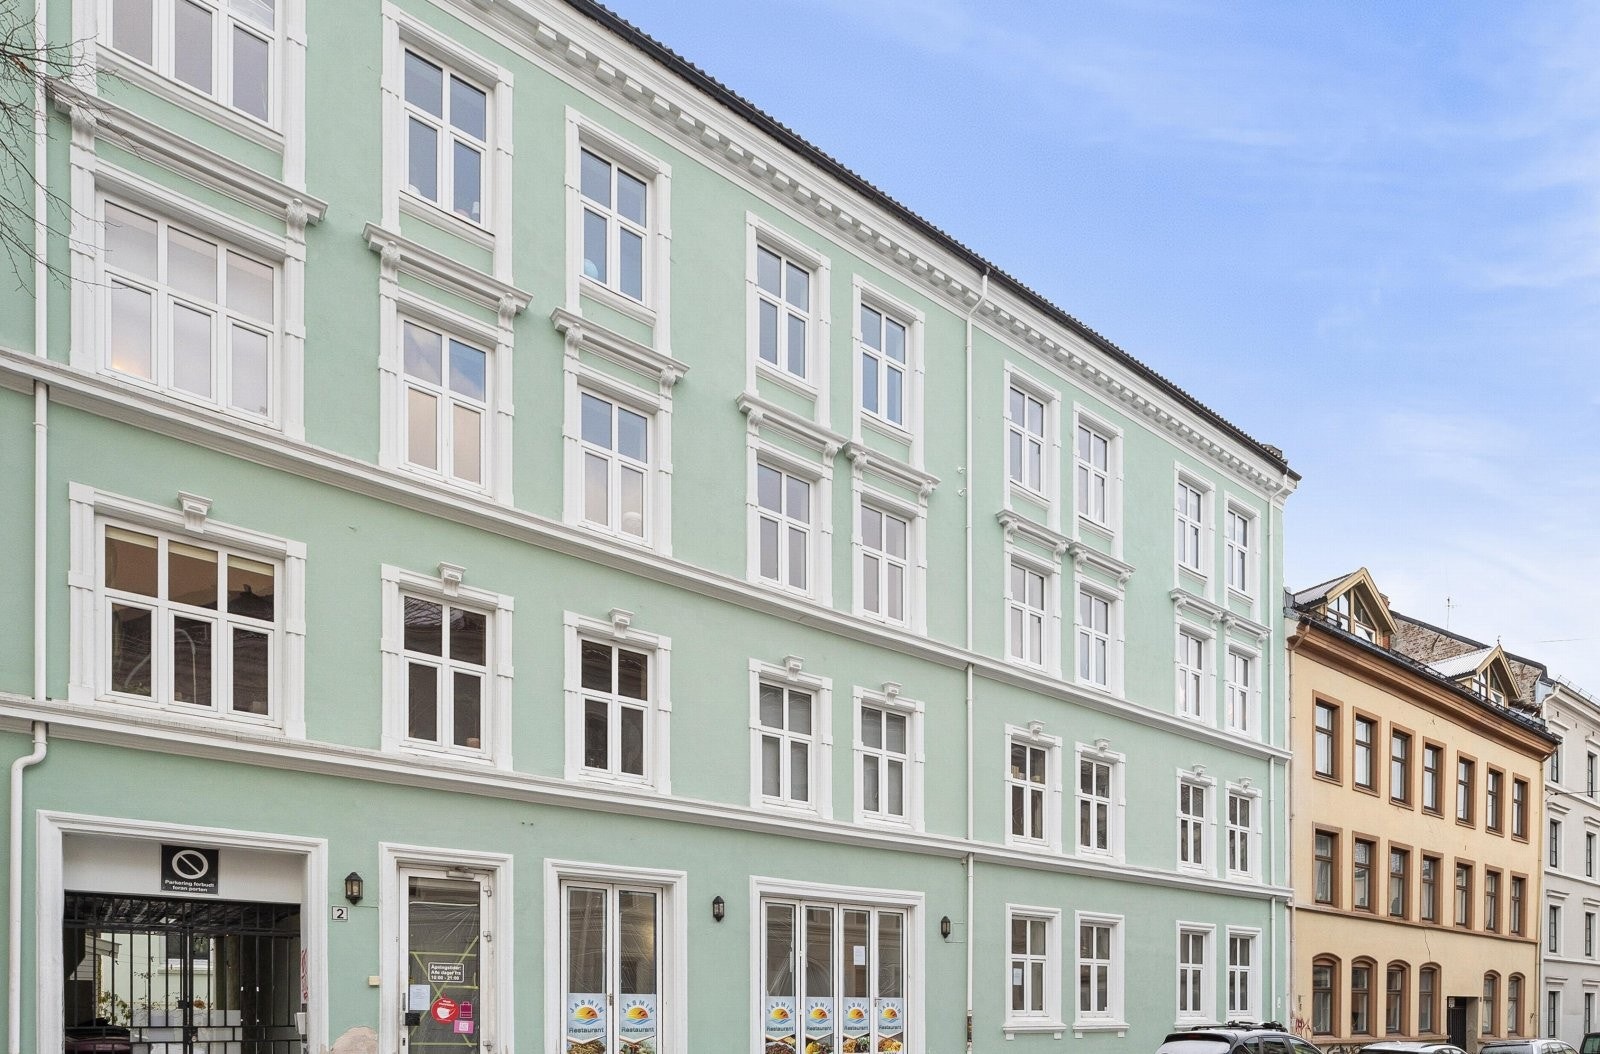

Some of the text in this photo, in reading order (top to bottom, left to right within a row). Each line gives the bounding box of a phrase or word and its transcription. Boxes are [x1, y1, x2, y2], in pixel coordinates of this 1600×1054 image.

[336, 908, 344, 919] 2
[569, 999, 604, 1014] JASMIN
[621, 999, 654, 1014] JASMIN
[767, 1001, 794, 1014] JASMIN
[807, 1002, 832, 1014] JASMIN
